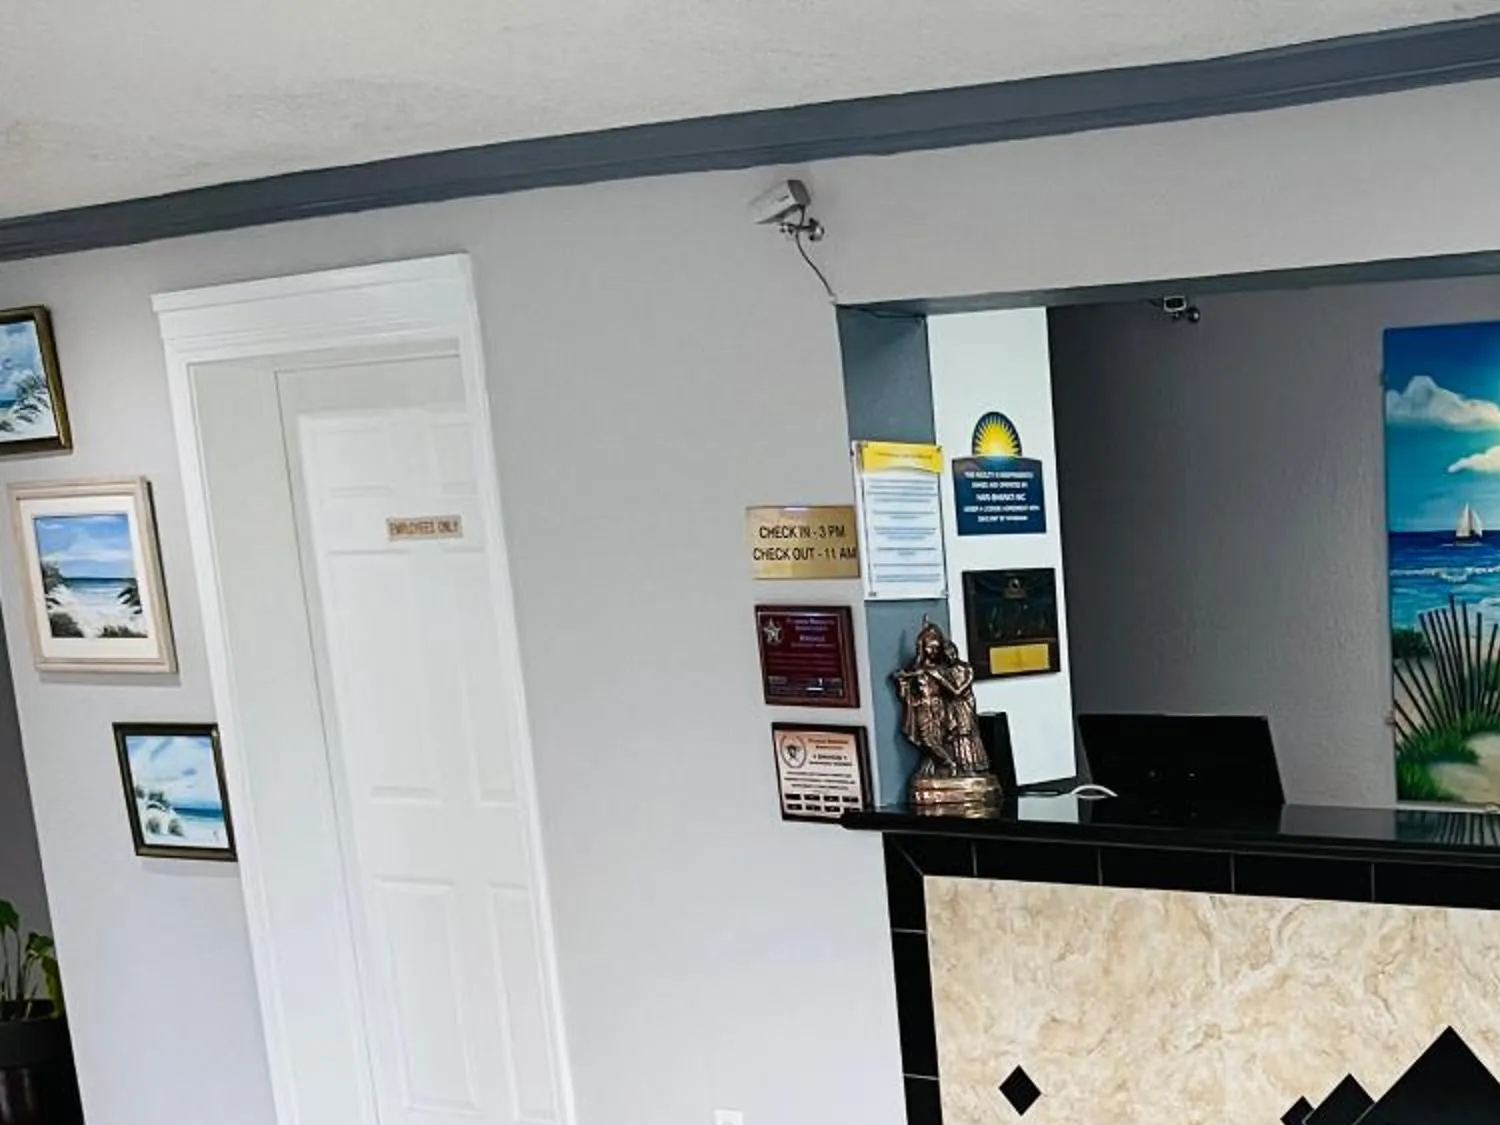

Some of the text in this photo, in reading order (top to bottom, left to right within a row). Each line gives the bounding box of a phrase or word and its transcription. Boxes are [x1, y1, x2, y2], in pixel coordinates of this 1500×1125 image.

[759, 525, 797, 539] CHECK
[799, 525, 811, 538] IN
[819, 525, 827, 538] 3
[828, 525, 845, 538] PM
[753, 547, 790, 561] CHECK
[792, 547, 814, 561] OUT
[825, 547, 837, 560] 11
[840, 546, 857, 559] AM
